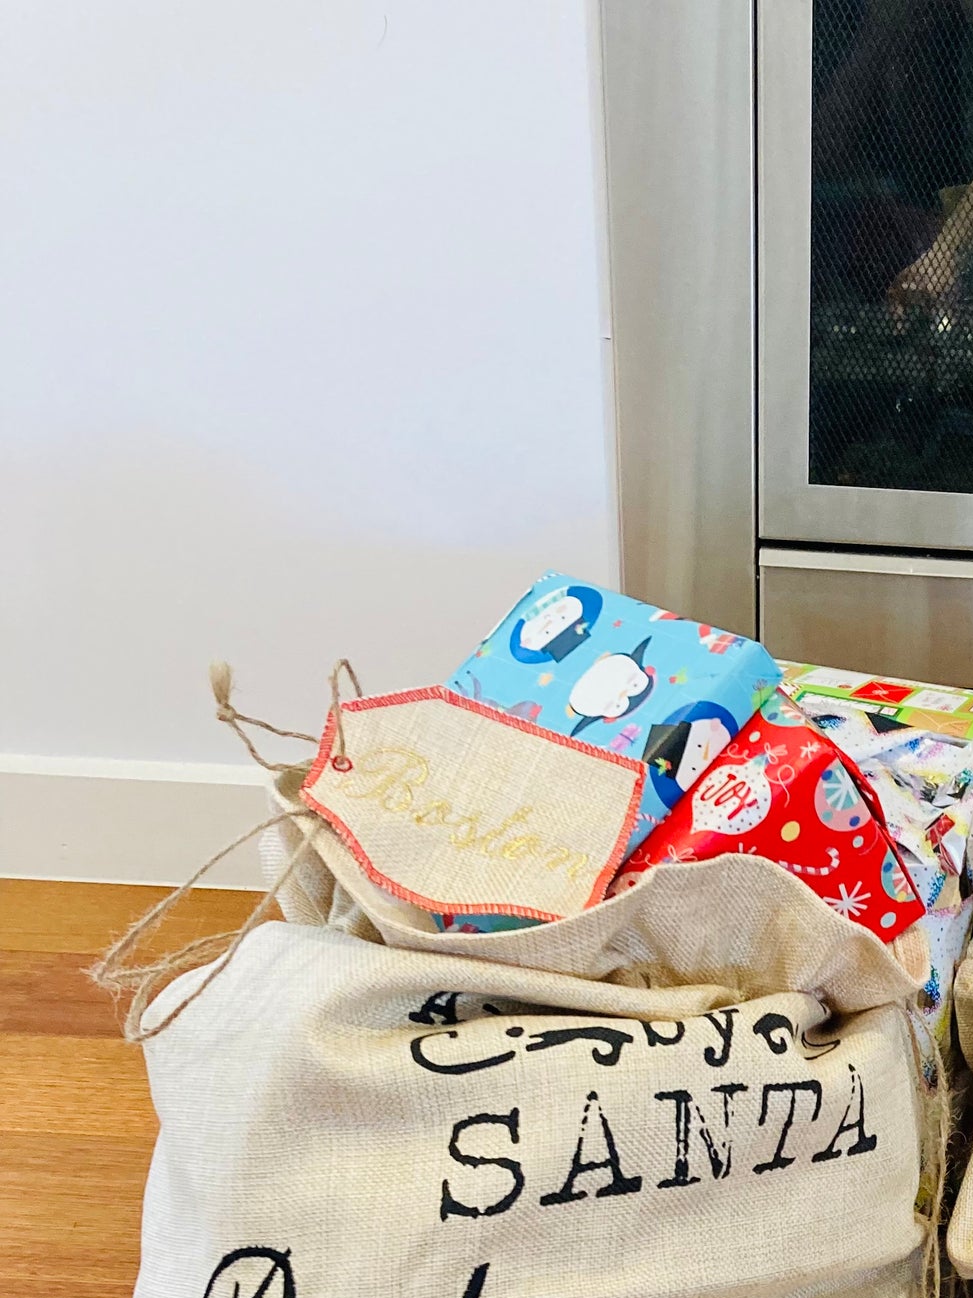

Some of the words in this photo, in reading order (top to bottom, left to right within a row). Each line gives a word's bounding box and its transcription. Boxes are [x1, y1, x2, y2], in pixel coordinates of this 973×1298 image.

[337, 747, 592, 881] Boston
[700, 773, 758, 820] JOY
[440, 1064, 877, 1222] SANTA
